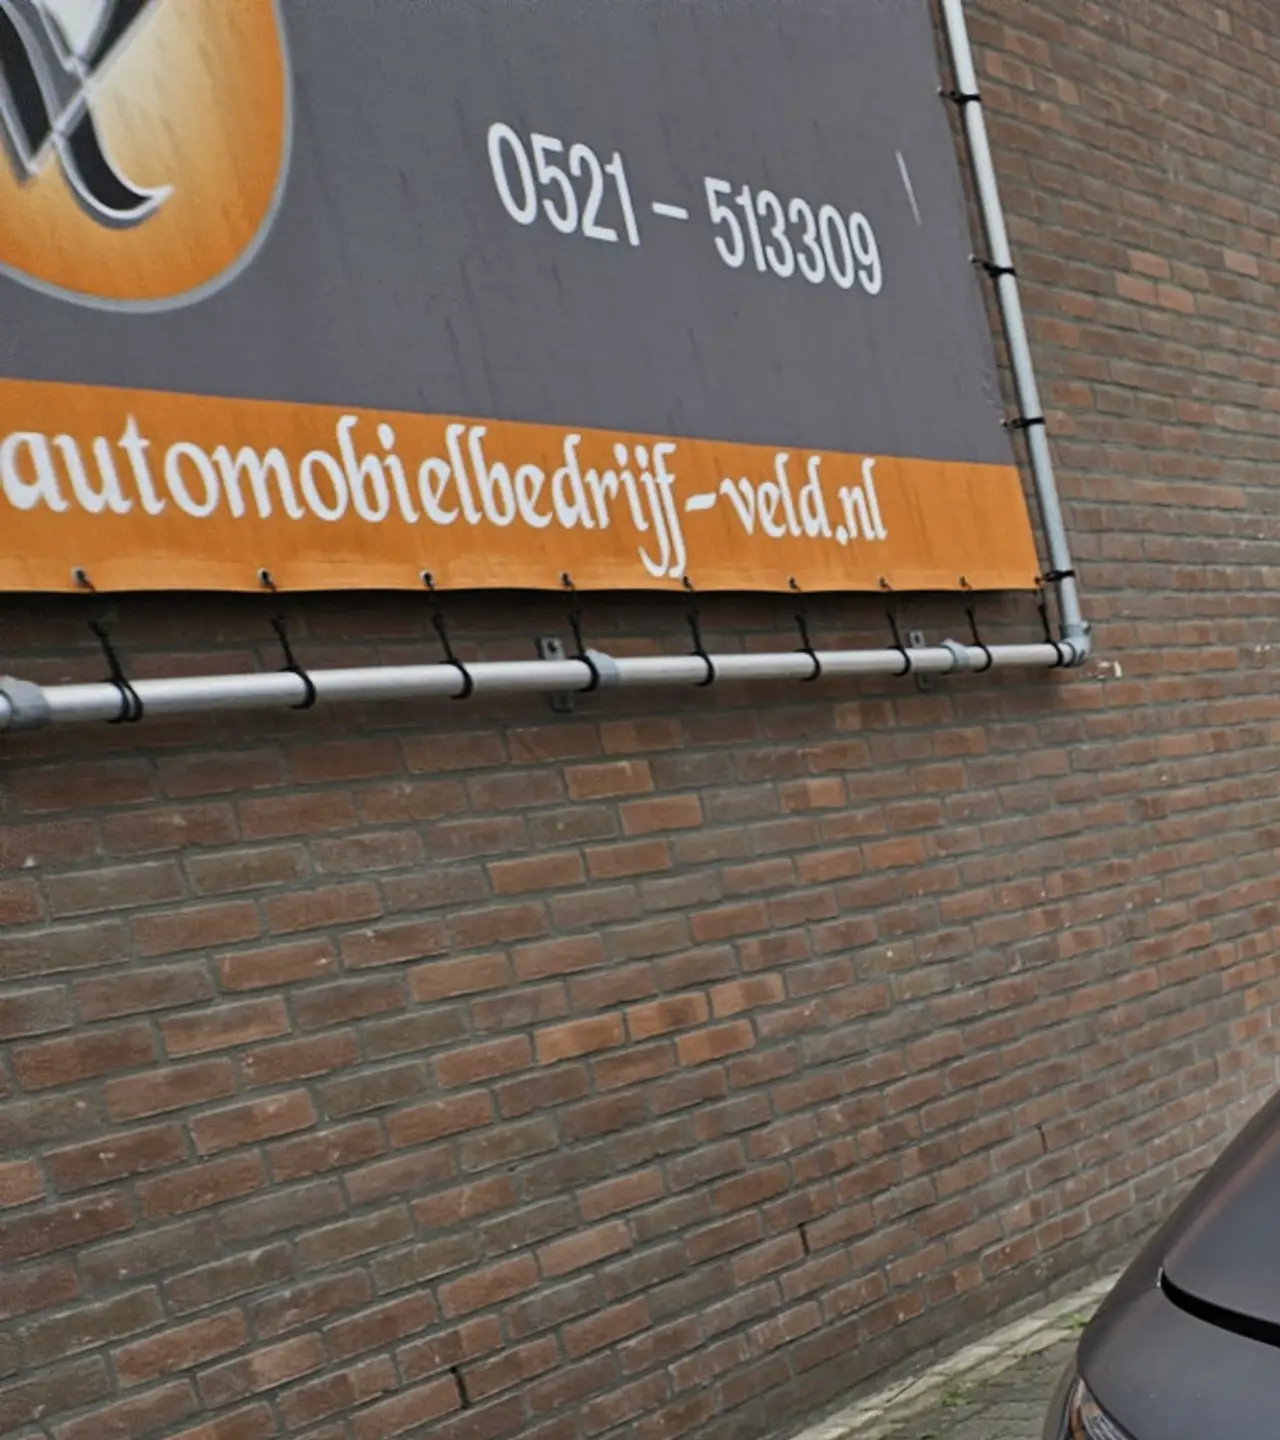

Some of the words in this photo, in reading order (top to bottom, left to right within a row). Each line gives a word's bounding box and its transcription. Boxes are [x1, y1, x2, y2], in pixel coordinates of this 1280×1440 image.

[487, 122, 641, 246] 0521
[704, 176, 883, 295] 513309
[0, 413, 888, 578] automobielbedrijf-veld.nl
